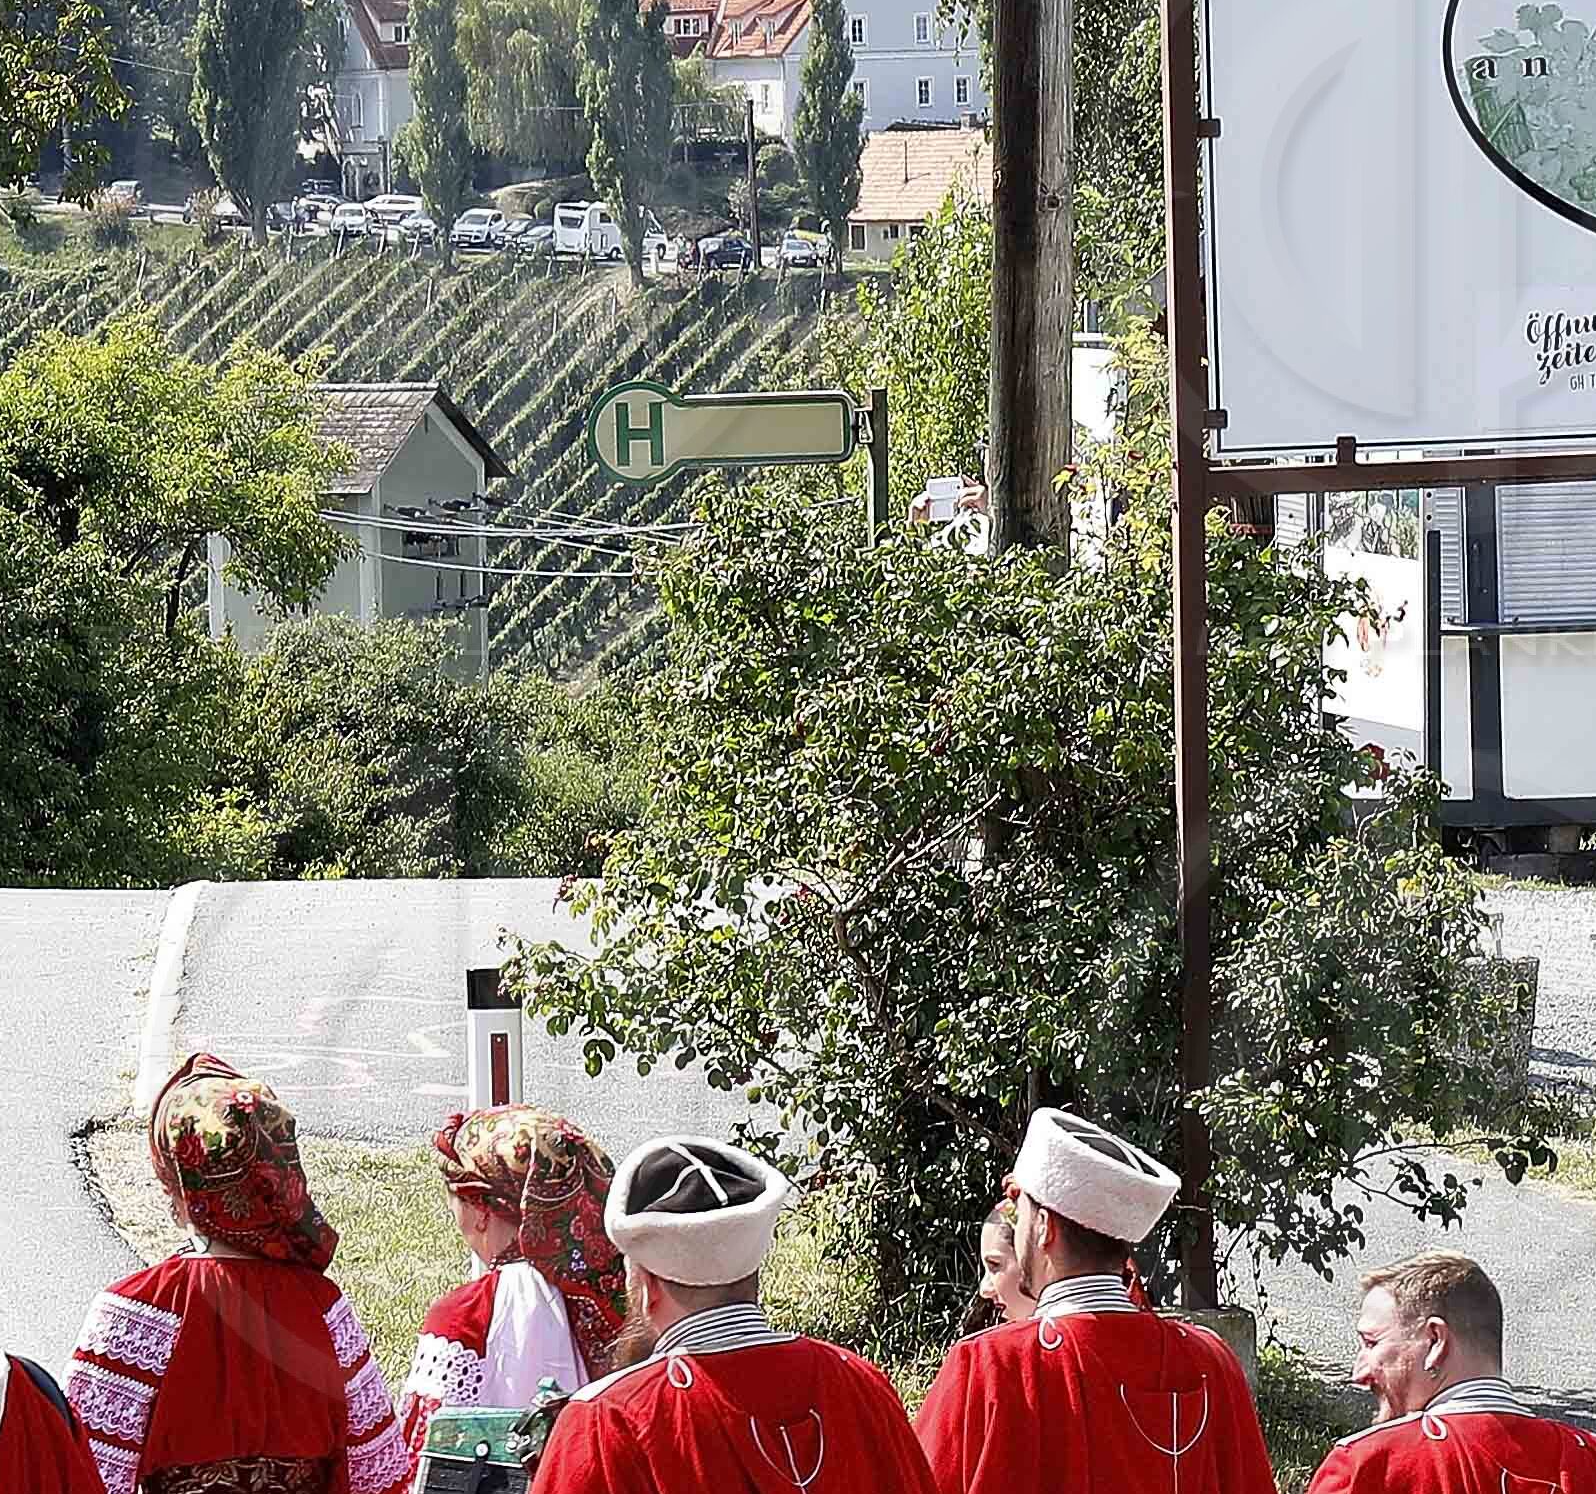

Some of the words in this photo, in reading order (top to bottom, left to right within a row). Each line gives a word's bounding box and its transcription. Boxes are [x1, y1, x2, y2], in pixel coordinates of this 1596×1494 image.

[1471, 53, 1551, 81] an
[1570, 375, 1584, 390] GH
[615, 402, 664, 467] H
